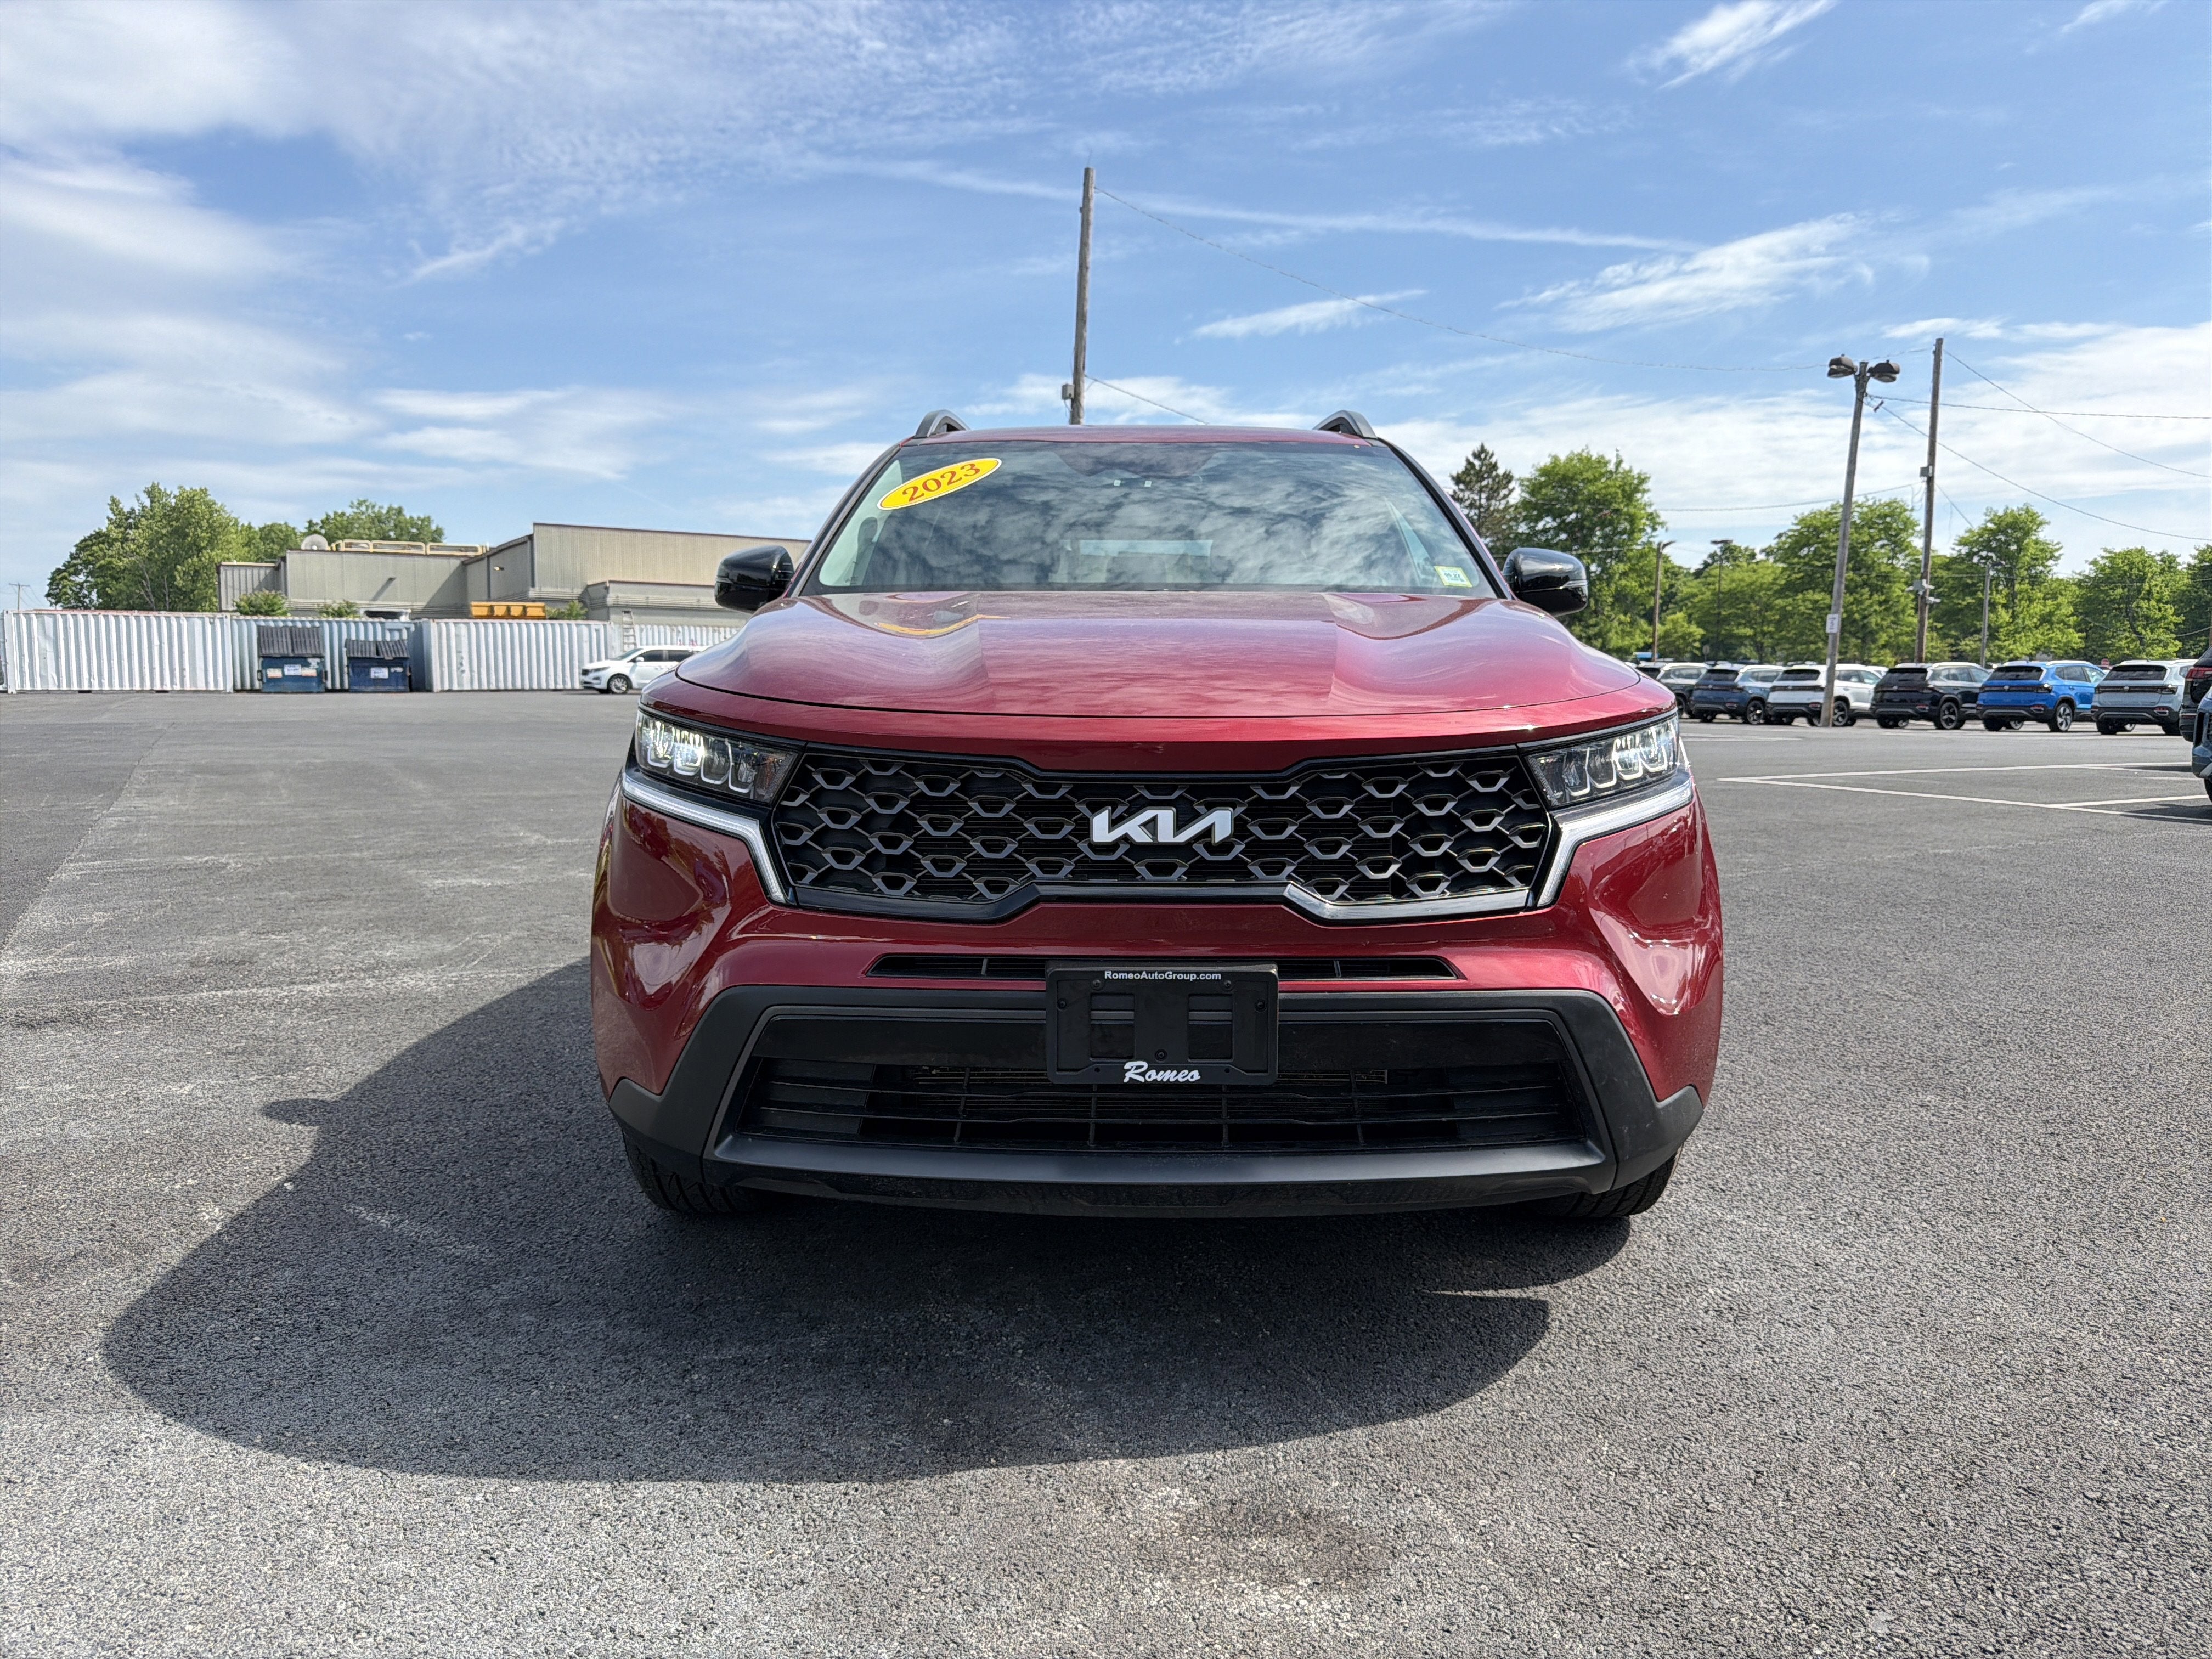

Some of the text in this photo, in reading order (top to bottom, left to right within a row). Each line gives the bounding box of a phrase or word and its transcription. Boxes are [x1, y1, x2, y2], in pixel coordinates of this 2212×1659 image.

[902, 464, 980, 502] 2023
[1091, 808, 1233, 844] KIA
[1104, 970, 1222, 981] RomeoAutoGroup.com
[1123, 1060, 1201, 1083] Romeo
